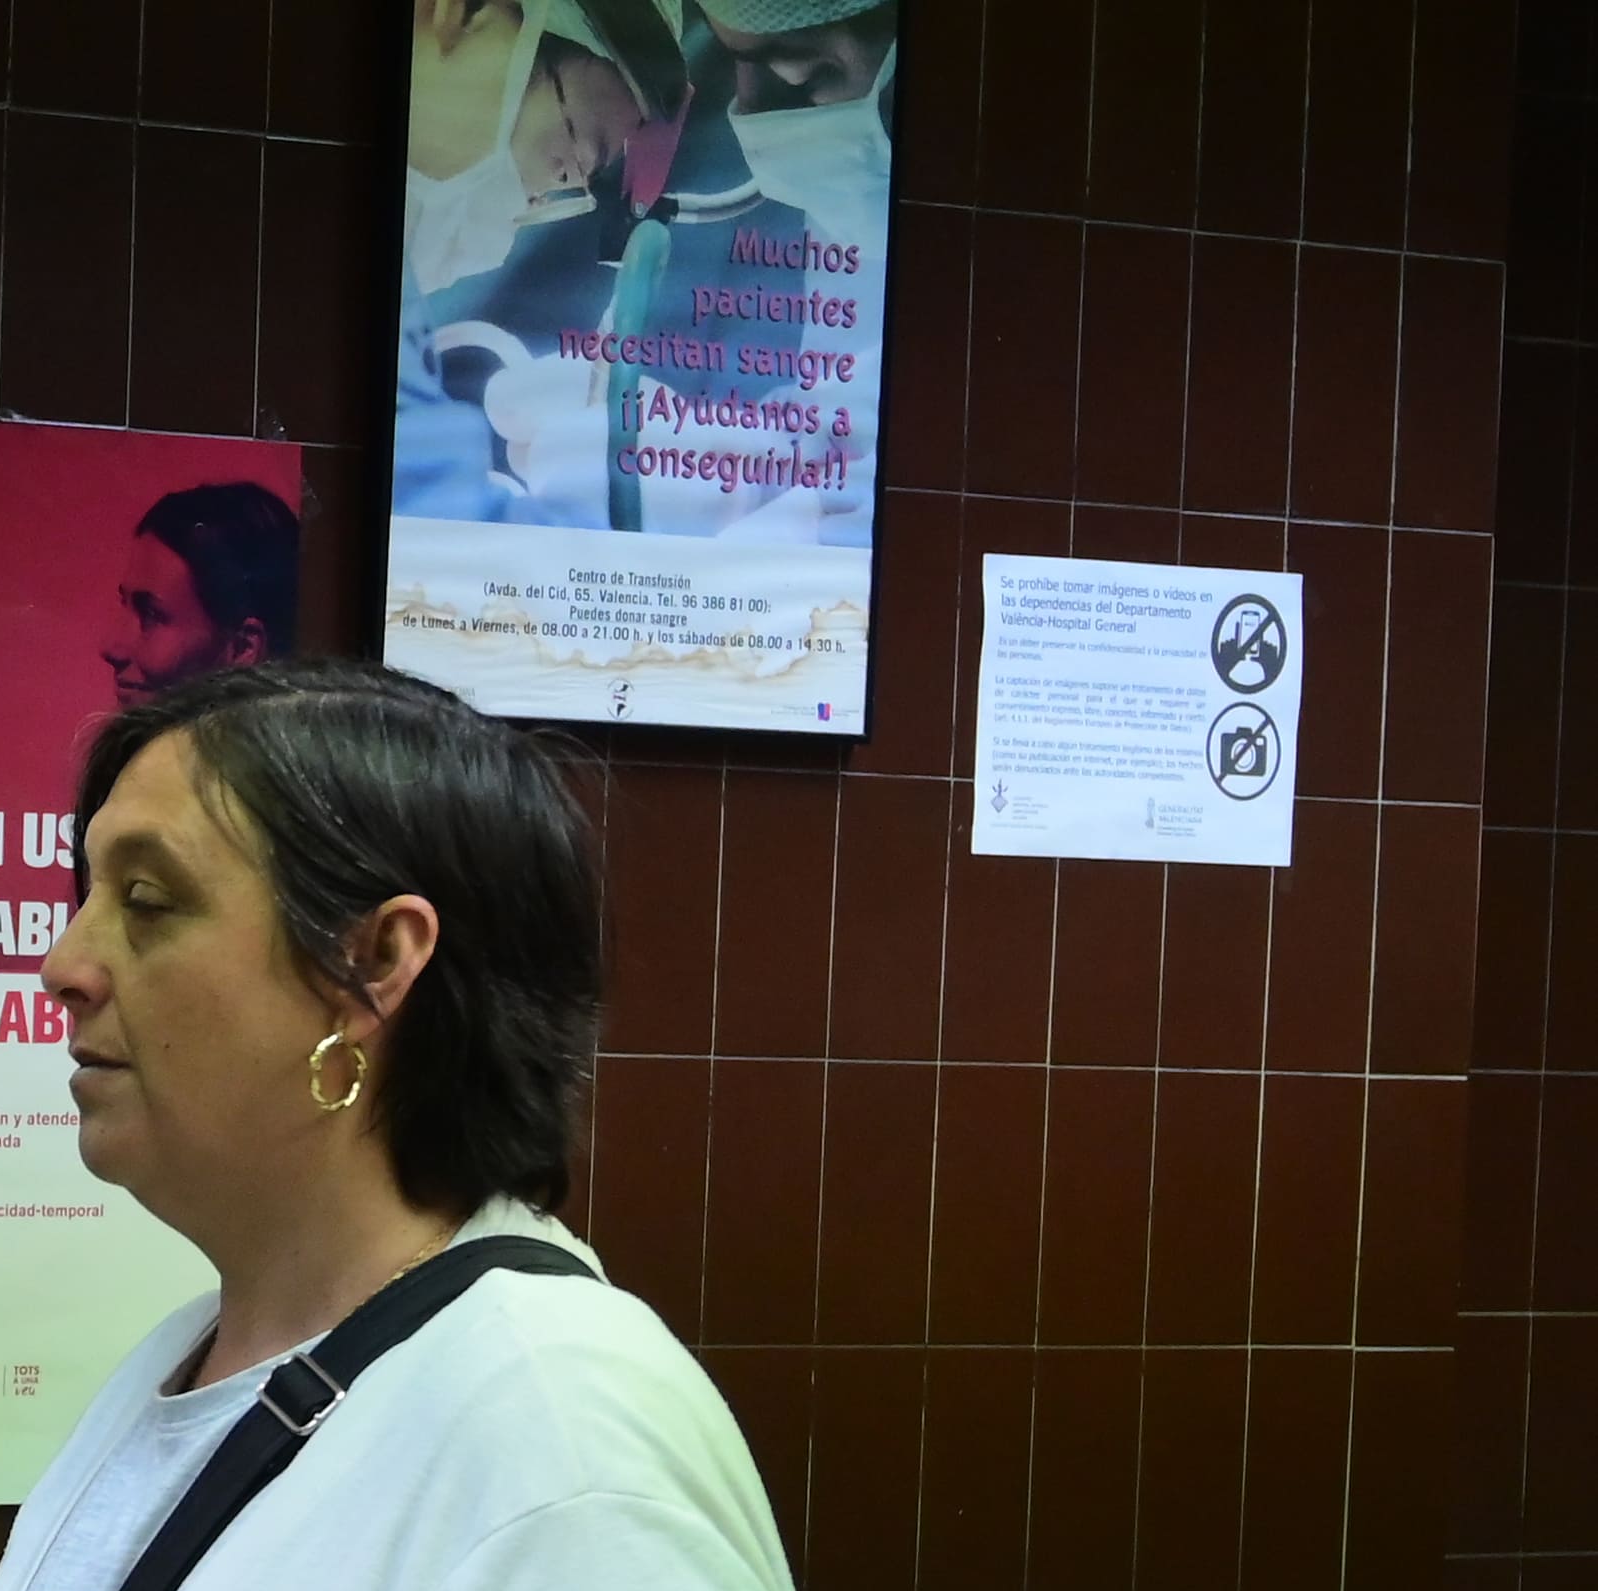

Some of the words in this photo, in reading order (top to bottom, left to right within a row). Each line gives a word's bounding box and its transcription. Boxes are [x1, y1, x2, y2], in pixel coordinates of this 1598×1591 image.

[729, 227, 860, 274] Muchos
[692, 286, 857, 328] pacientes
[559, 327, 726, 372] necesitan
[738, 348, 855, 390] sangre
[832, 405, 851, 436] a
[617, 442, 847, 493] conseguirla!!
[568, 568, 606, 584] Centro
[610, 571, 623, 584] de
[628, 572, 691, 589] Transfusión
[1001, 576, 1014, 589] Se
[1063, 580, 1093, 593] tomar
[1098, 581, 1149, 600] imágenes
[1153, 590, 1160, 598] o
[1163, 586, 1197, 601] vídeos
[1200, 592, 1213, 601] en
[484, 582, 521, 598] (Avda.
[526, 585, 544, 598] del
[657, 592, 677, 607] Tel.
[682, 595, 697, 608] 96
[702, 596, 725, 609] 386
[730, 598, 743, 611] 81
[1002, 594, 1017, 608] las
[1020, 595, 1092, 613] dependencias
[1096, 601, 1112, 613] del
[1116, 602, 1192, 619] Departamento
[570, 606, 611, 622] Puedes
[615, 609, 646, 624] donar
[650, 613, 687, 627] sangre
[1095, 618, 1137, 633] General
[403, 614, 417, 627] de
[421, 615, 455, 629] Lunes
[460, 620, 467, 630] a
[471, 618, 519, 636] Viernes,
[523, 622, 537, 634] de
[542, 622, 577, 638] 08.00
[582, 627, 589, 638] a
[593, 625, 629, 641] 21.00
[633, 627, 643, 641] h.
[647, 632, 653, 645] y
[658, 630, 674, 643] los
[678, 631, 726, 647] sábados
[730, 633, 744, 648] de
[748, 635, 783, 650] 08.00
[786, 640, 793, 650] a
[798, 637, 832, 652] 14.30
[836, 640, 846, 653] h.
[23, 811, 76, 869] US
[13, 1112, 23, 1128] y
[14, 1366, 40, 1376] TOTS
